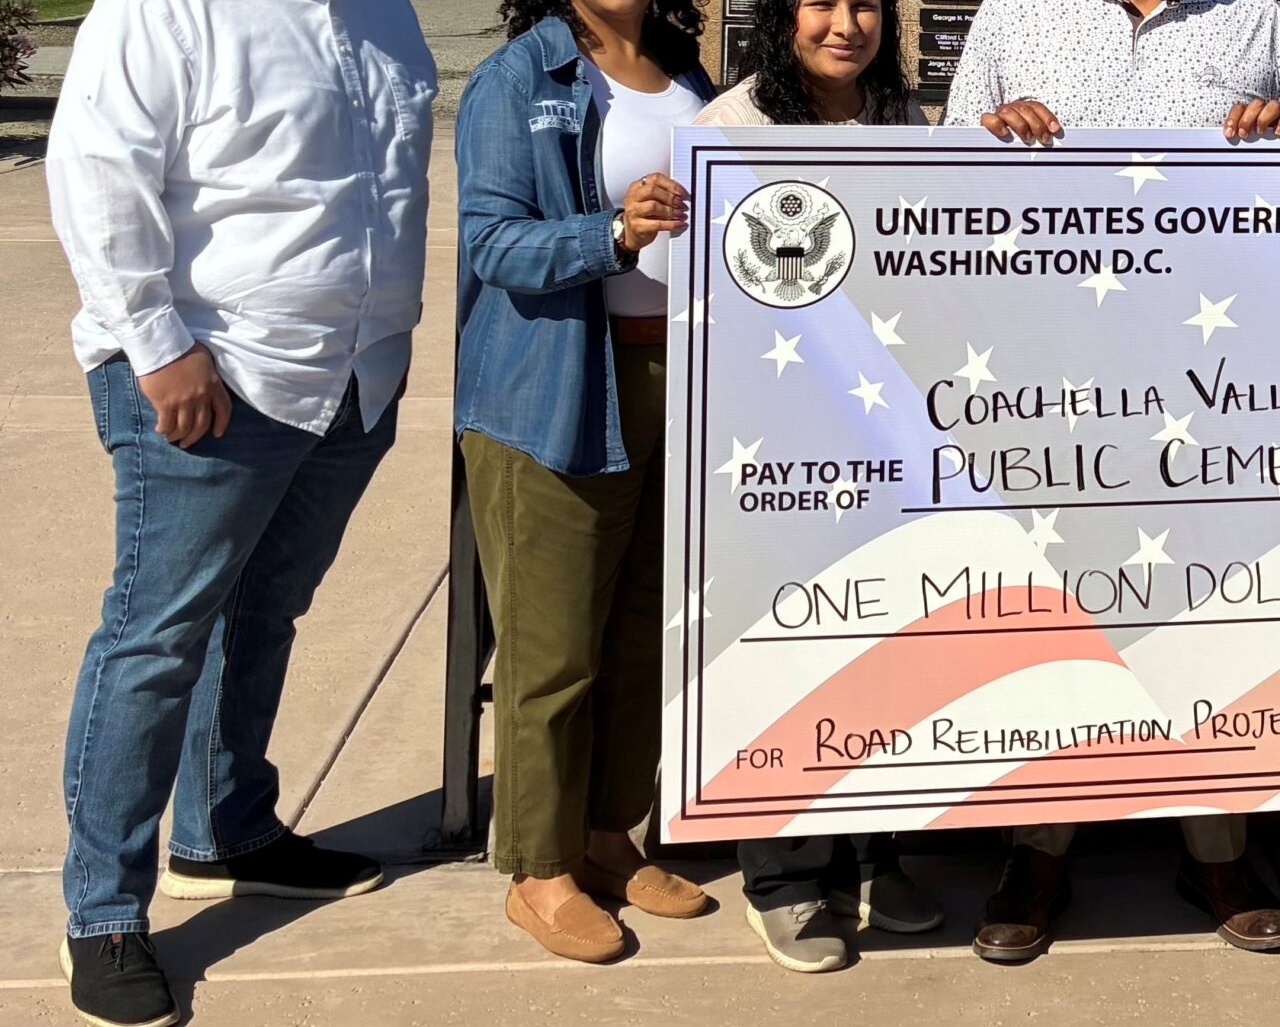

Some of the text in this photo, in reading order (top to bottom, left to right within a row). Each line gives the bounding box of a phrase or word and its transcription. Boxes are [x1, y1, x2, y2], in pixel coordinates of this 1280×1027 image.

[932, 14, 956, 22] George
[875, 206, 1012, 237] UNITED
[1021, 206, 1145, 236] STATES
[874, 247, 1173, 278] WASHINGTON D.C.
[740, 459, 903, 486] PAY TO THE
[931, 442, 1131, 504] PUBLIC
[739, 489, 869, 513] ORDER OF
[774, 576, 888, 630] ONE
[923, 561, 1154, 621] MILLION
[817, 717, 915, 763] ROAD
[934, 715, 1173, 755] REHABILITATION
[738, 746, 786, 770] FOR
